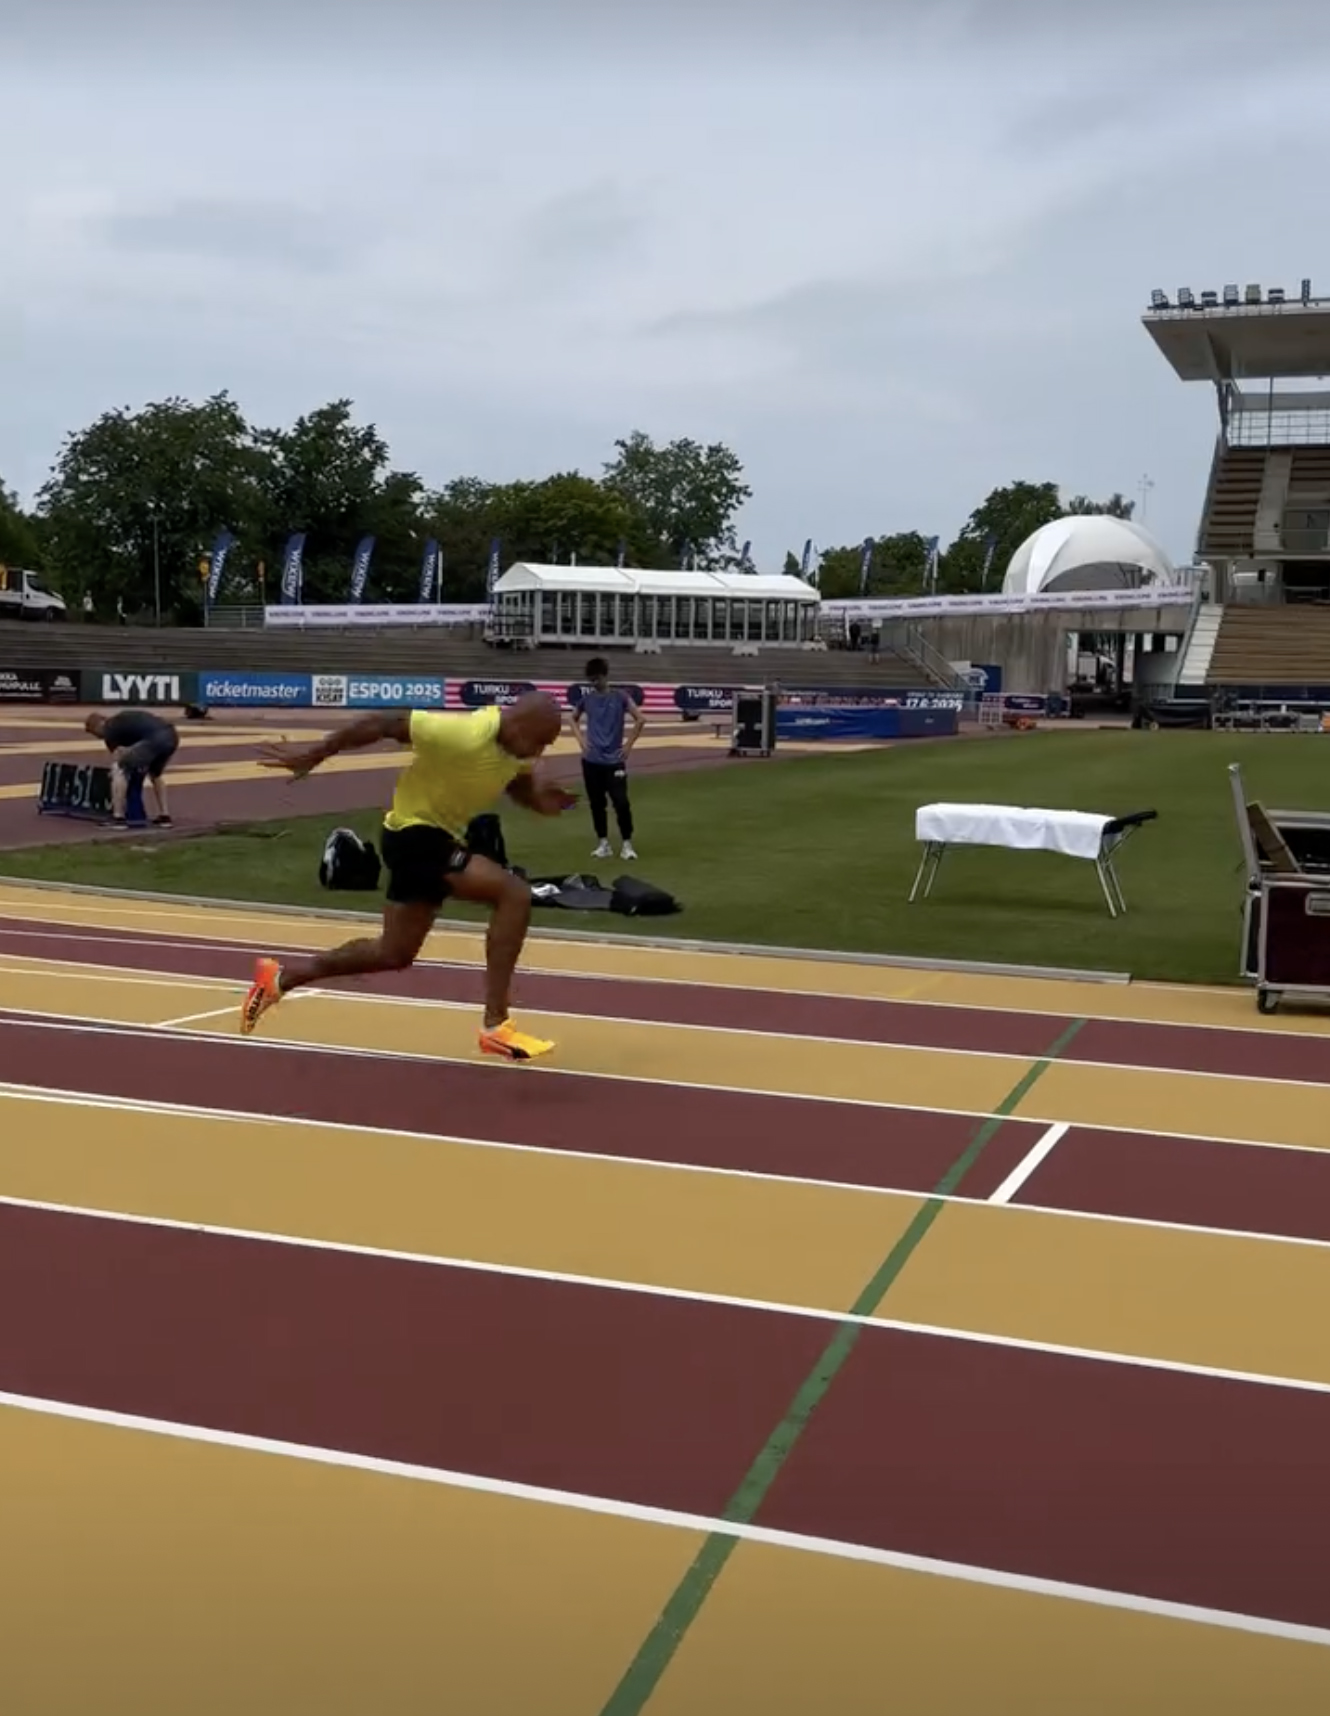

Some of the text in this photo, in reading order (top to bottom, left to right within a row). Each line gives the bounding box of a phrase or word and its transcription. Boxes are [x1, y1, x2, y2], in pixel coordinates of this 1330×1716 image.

[102, 674, 179, 701] LYYTI
[206, 680, 300, 698] ticketmaster
[349, 682, 403, 700] ESPOO
[405, 683, 441, 699] 2025
[473, 684, 510, 695] TURKU
[687, 688, 724, 699] TURKU
